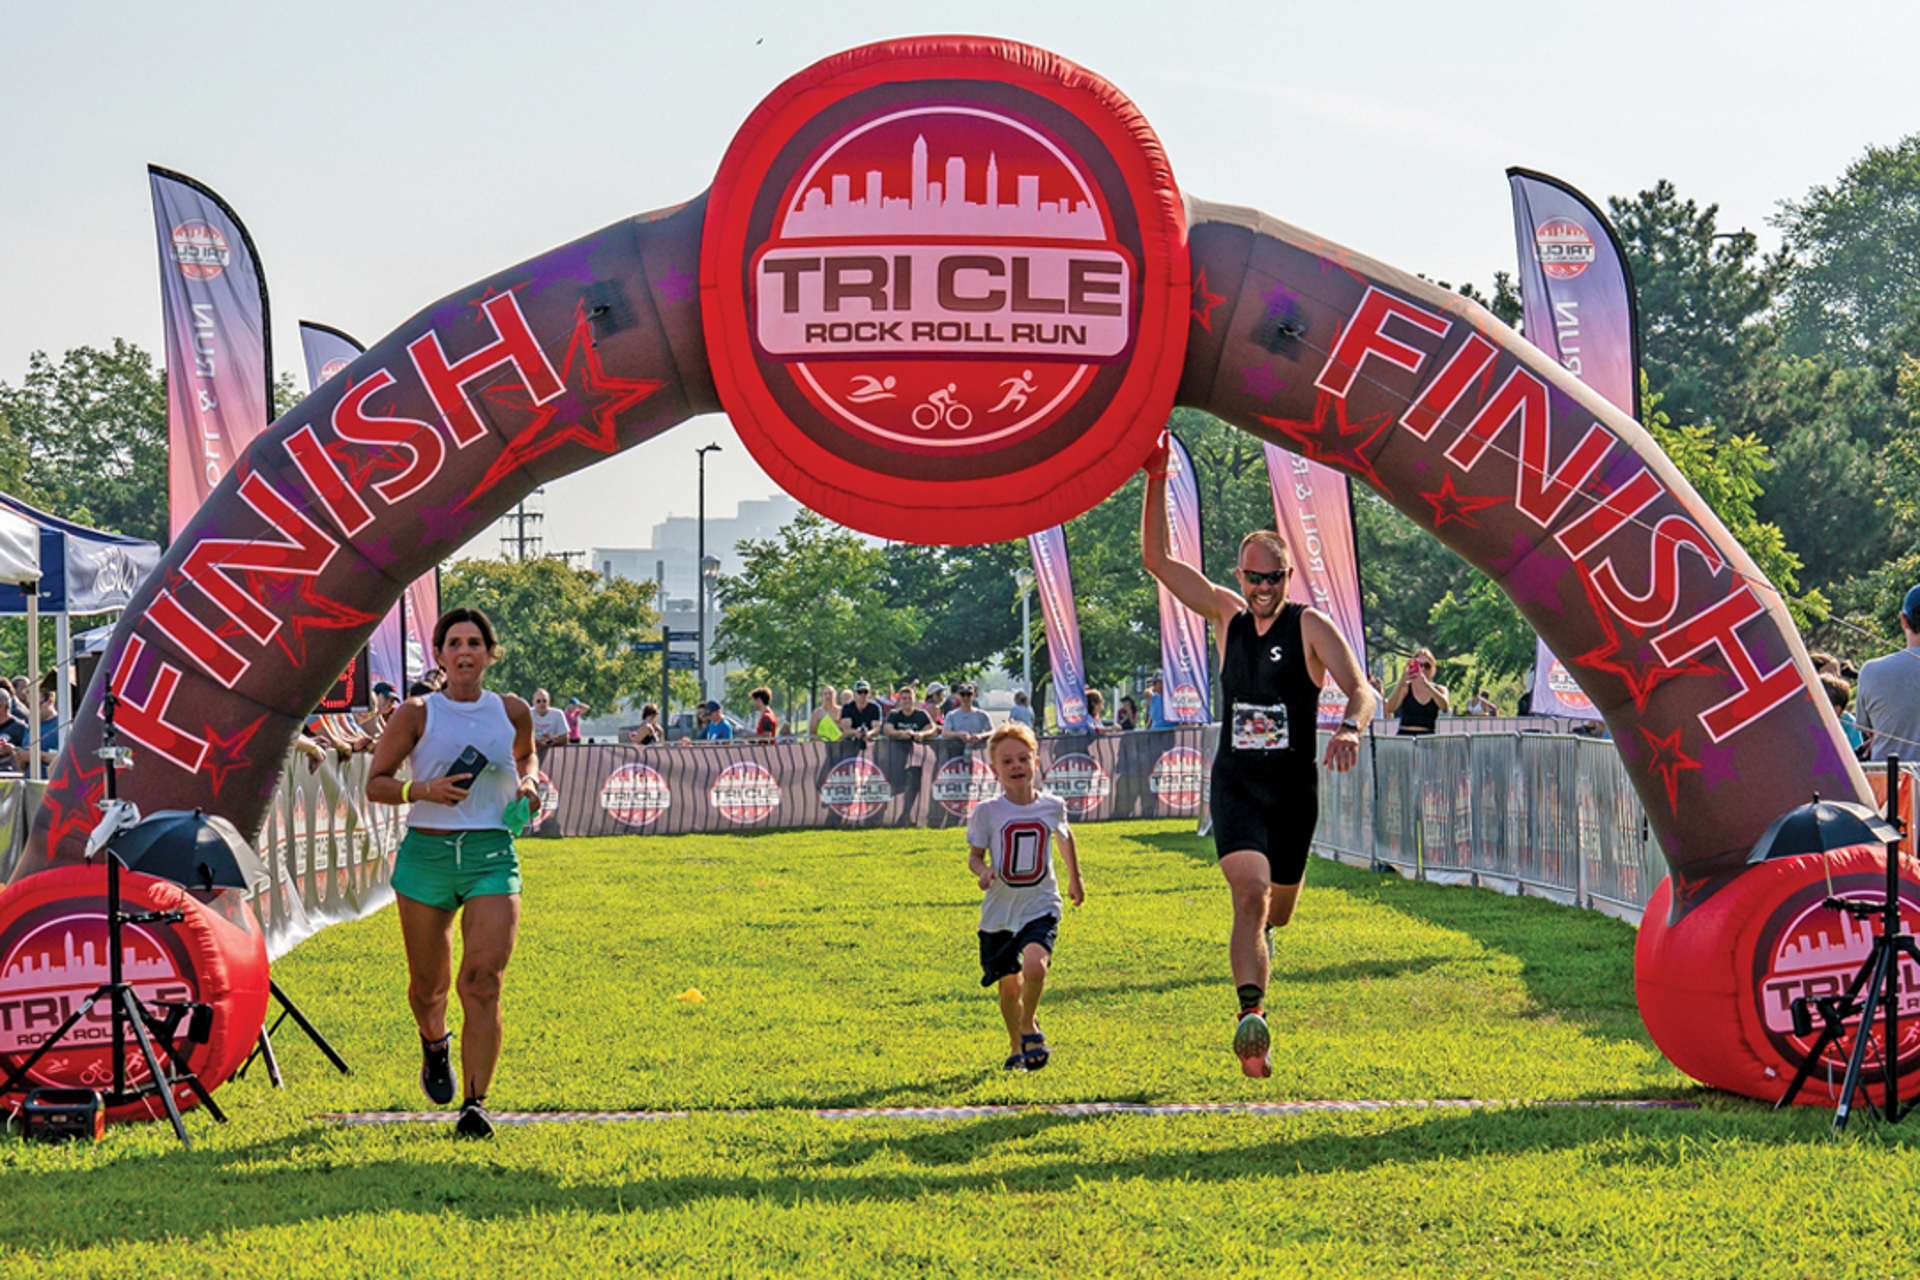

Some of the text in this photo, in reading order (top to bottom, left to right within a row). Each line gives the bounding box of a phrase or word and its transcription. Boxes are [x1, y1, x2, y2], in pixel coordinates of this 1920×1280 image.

[764, 254, 1123, 317] TRI CLE
[805, 321, 1087, 345] ROCK ROLL RUN
[1314, 286, 1808, 743] FINISH
[97, 288, 566, 774] FINISH
[823, 785, 851, 797] TRI
[935, 782, 961, 793] TRI
[0, 996, 70, 1031] TRI
[73, 1028, 114, 1040] ROL
